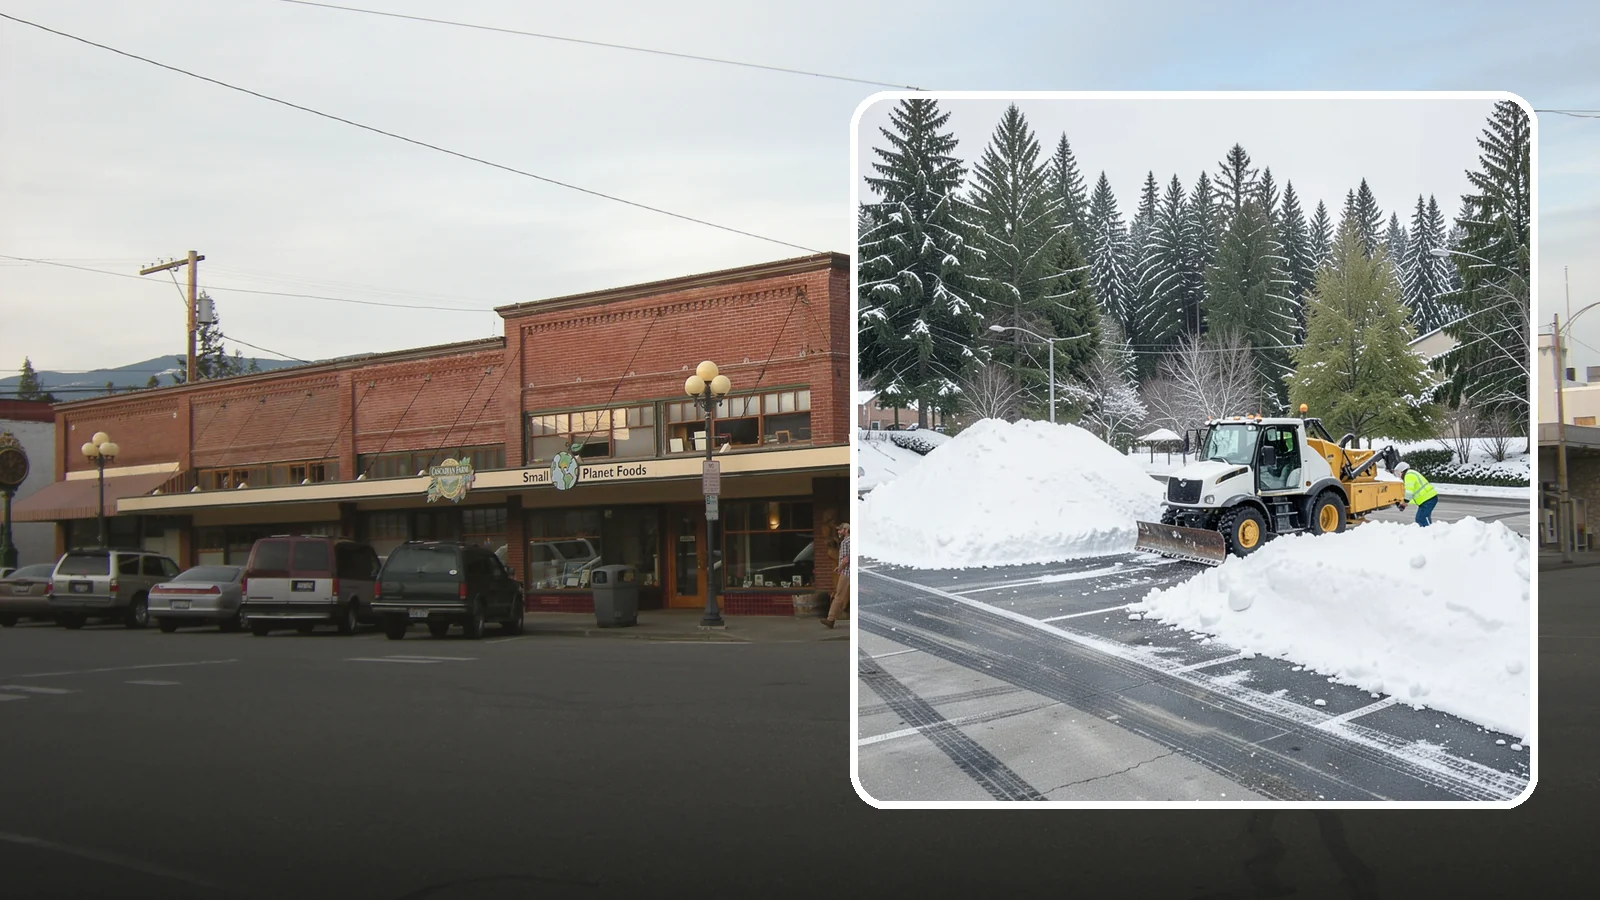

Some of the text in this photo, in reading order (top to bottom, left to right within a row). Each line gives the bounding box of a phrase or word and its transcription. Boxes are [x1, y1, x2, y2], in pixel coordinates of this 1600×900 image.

[523, 464, 647, 483] Small Planet Foods
